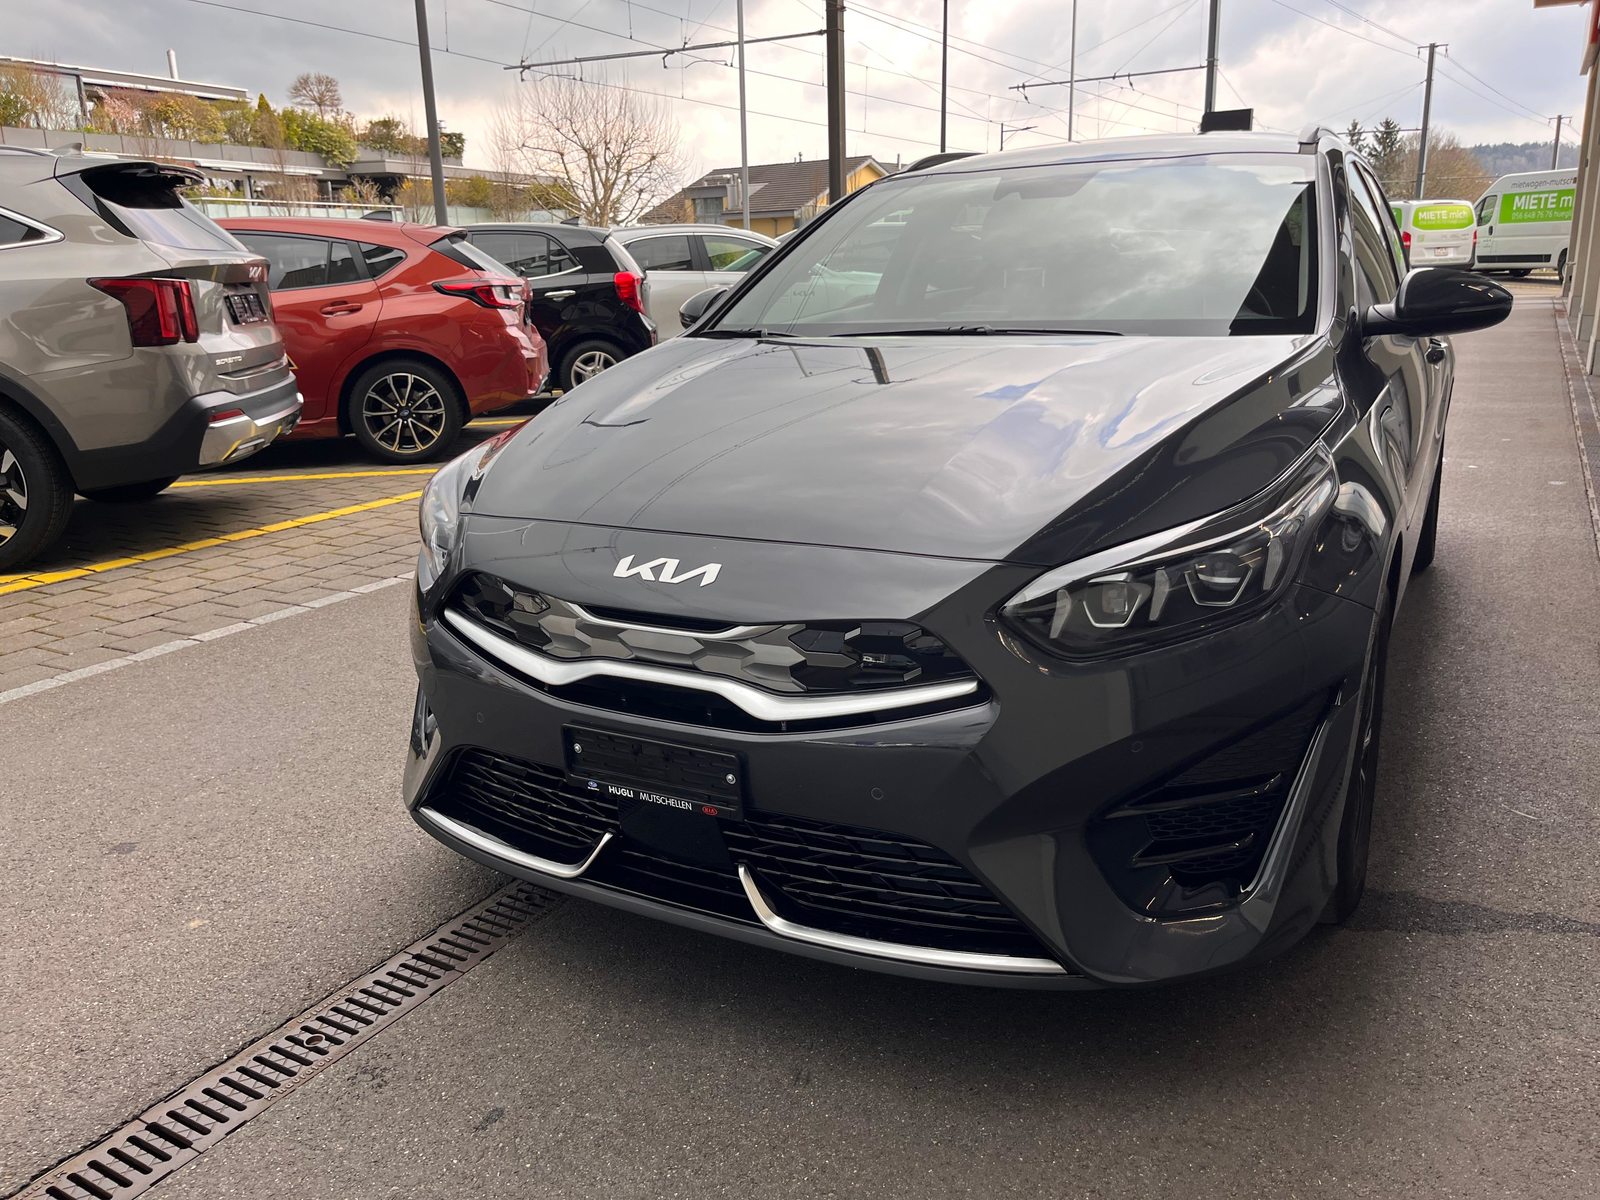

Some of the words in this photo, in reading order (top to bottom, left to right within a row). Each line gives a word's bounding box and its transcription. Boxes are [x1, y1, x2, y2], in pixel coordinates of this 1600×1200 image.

[1513, 193, 1557, 210] MIETE
[1418, 210, 1447, 220] MIETE
[613, 554, 722, 587] KIA
[639, 792, 693, 811] MUTSCHELLEN
